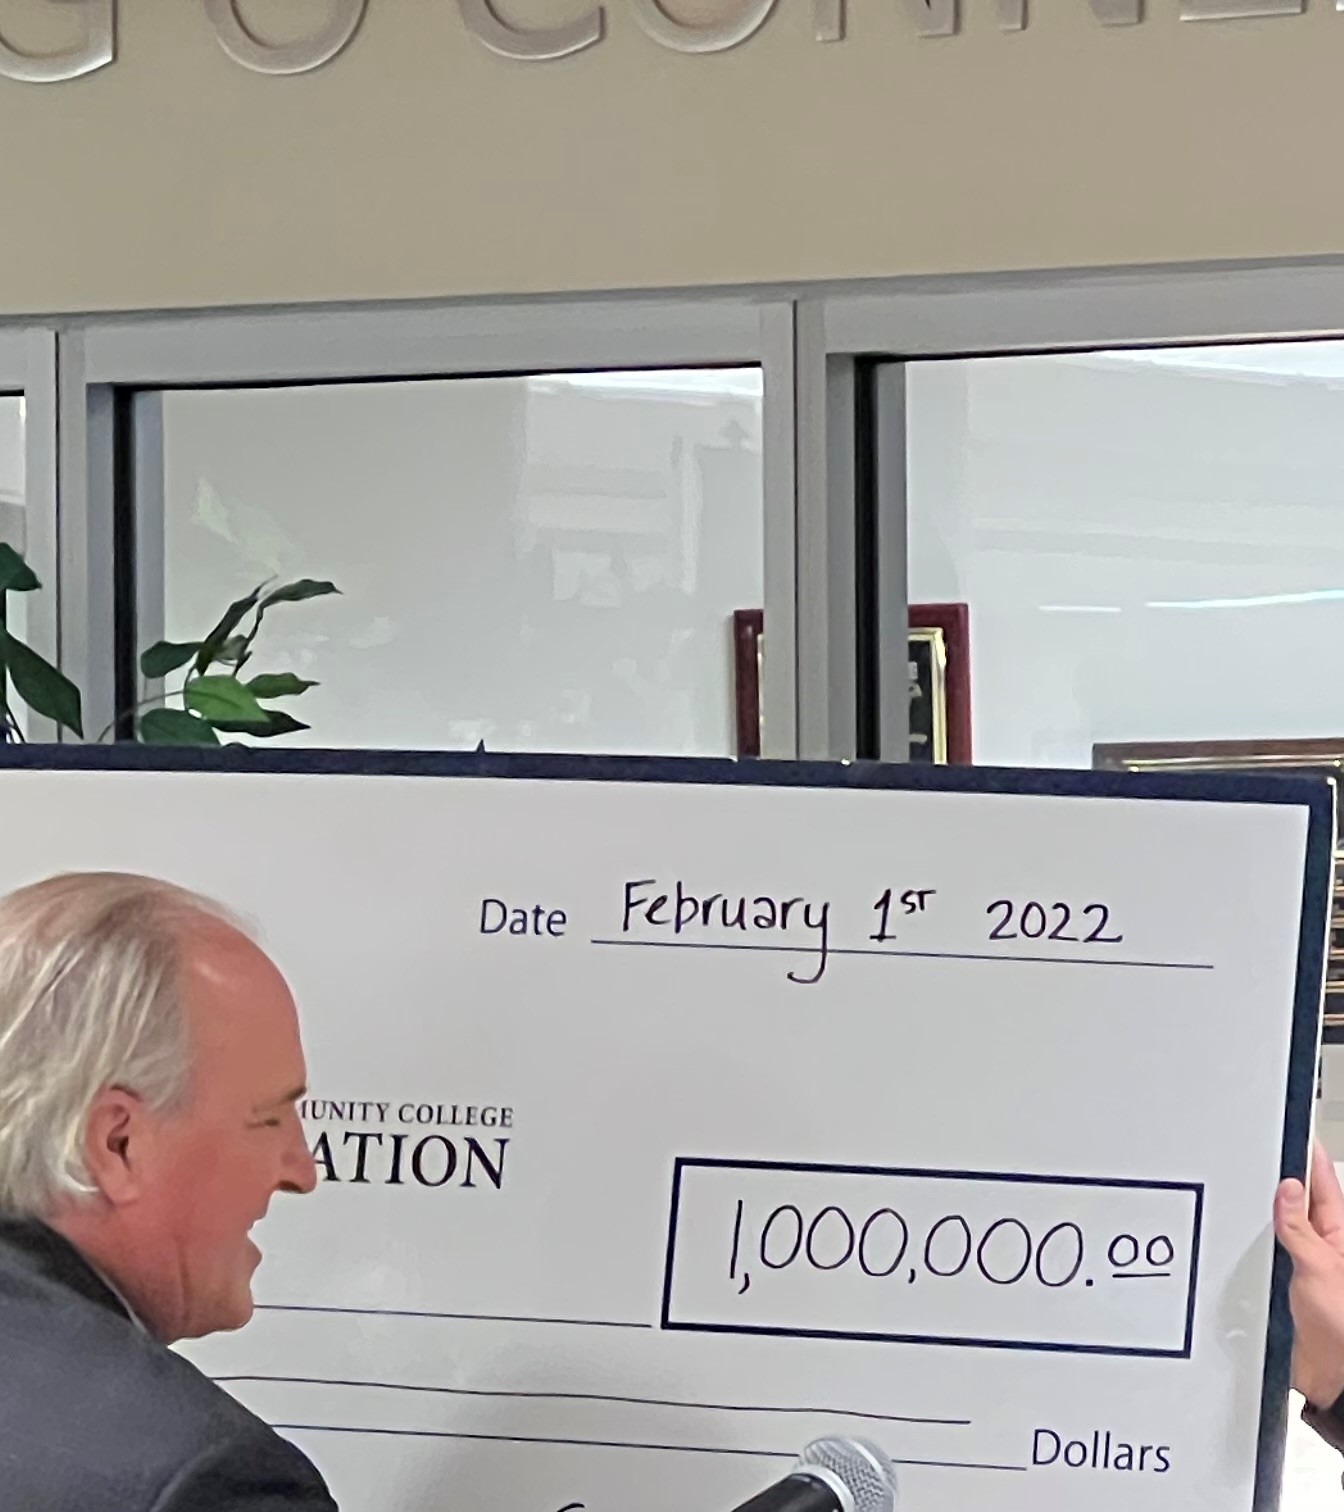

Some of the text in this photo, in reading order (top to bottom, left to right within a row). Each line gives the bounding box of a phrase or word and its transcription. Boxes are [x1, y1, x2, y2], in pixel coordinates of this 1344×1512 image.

[479, 898, 567, 936] Date
[623, 879, 830, 983] February
[988, 900, 1124, 943] 2022
[398, 1103, 514, 1128] COLLEGE
[311, 1130, 512, 1191] ATION
[1032, 1428, 1171, 1474] Dollars
